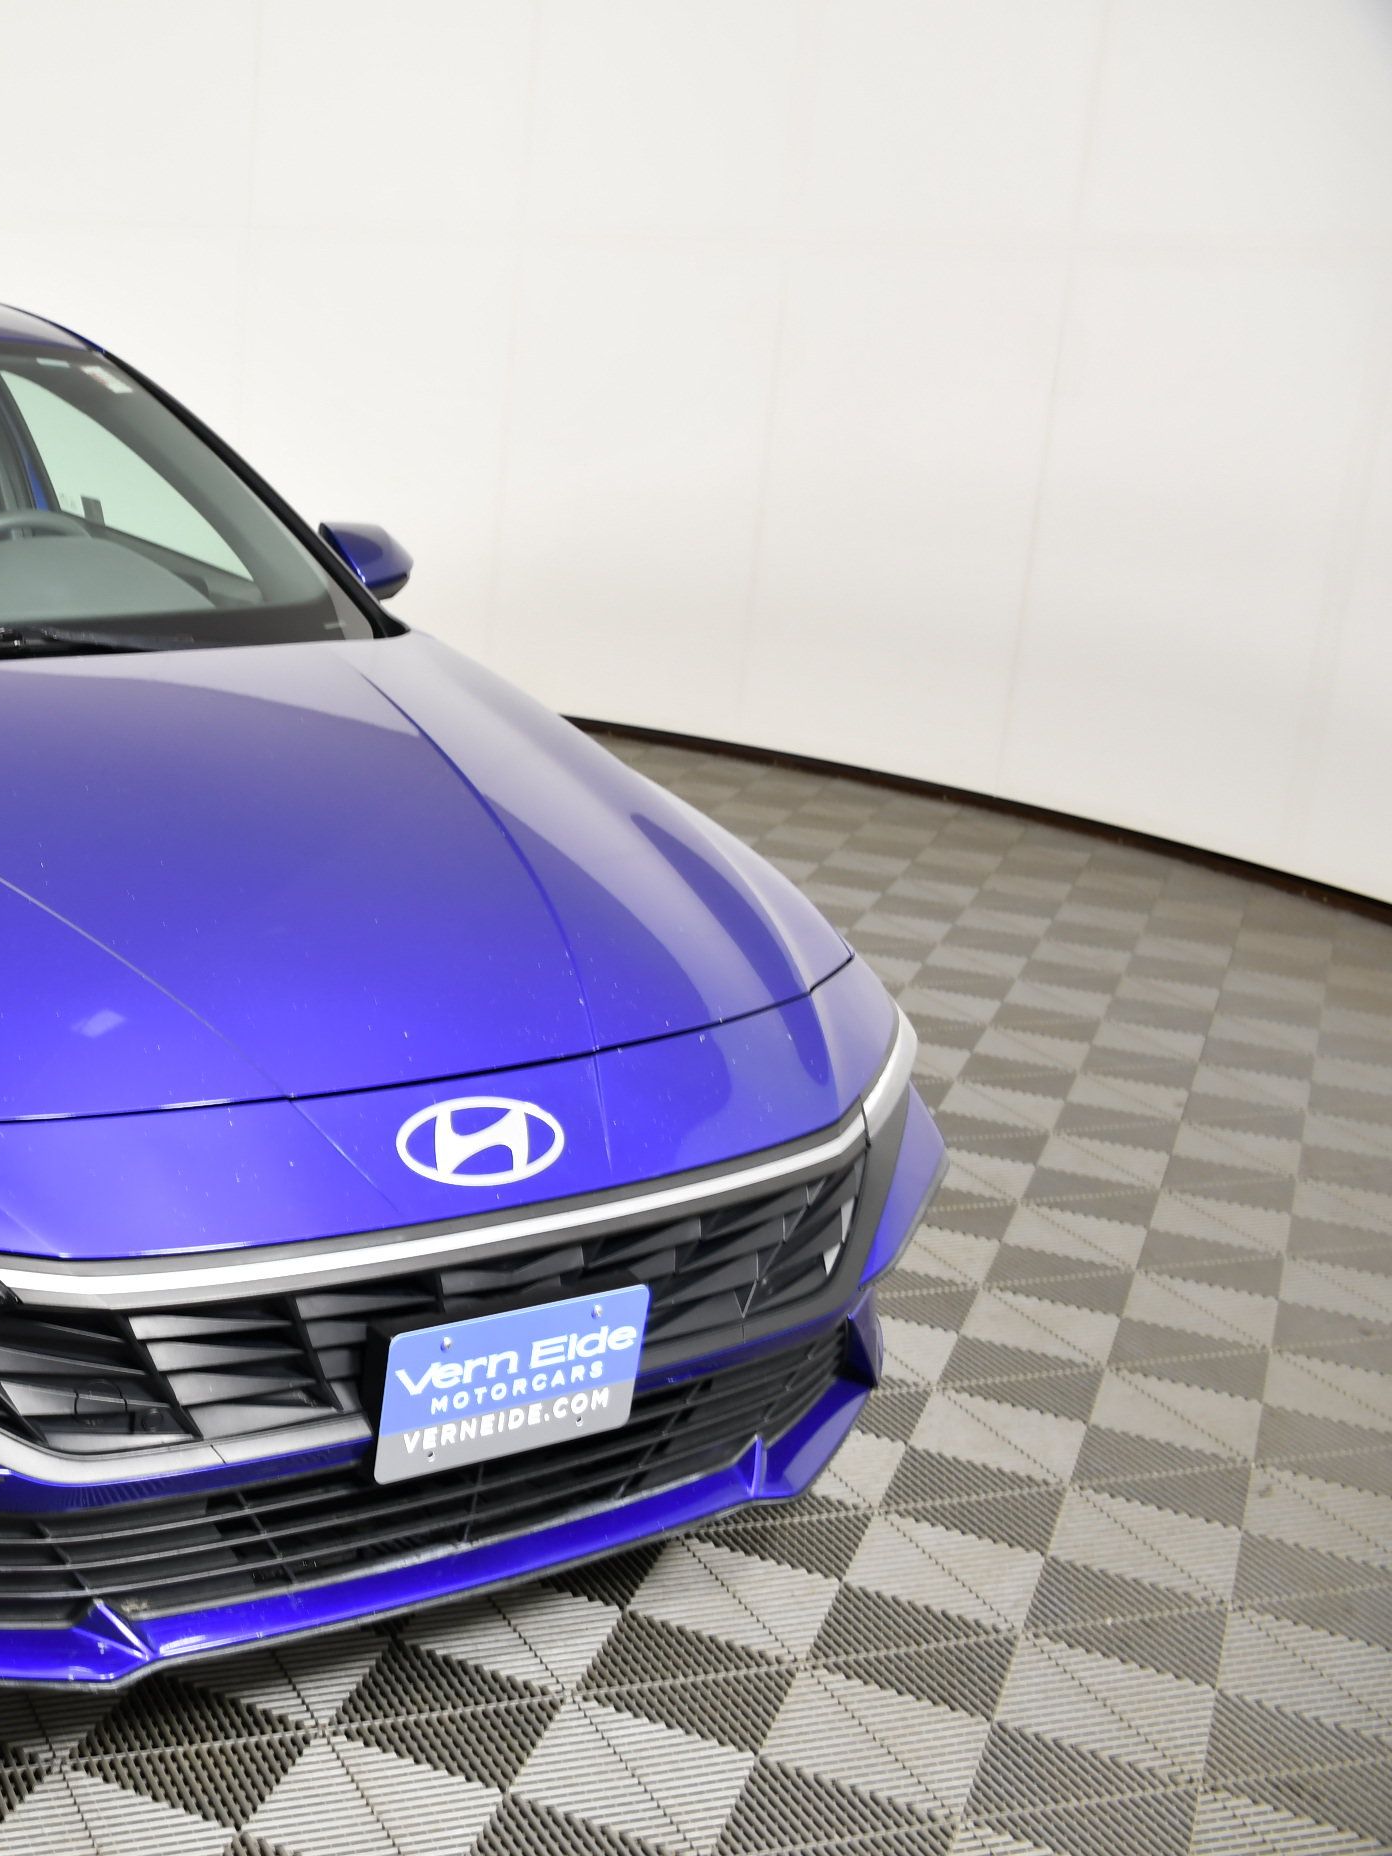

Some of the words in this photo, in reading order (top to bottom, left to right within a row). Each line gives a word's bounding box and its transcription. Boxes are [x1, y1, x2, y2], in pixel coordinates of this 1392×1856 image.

[395, 1350, 519, 1396] Vern
[430, 1360, 604, 1415] MOTORCARS
[403, 1387, 609, 1454] VERNEIDE.COM
